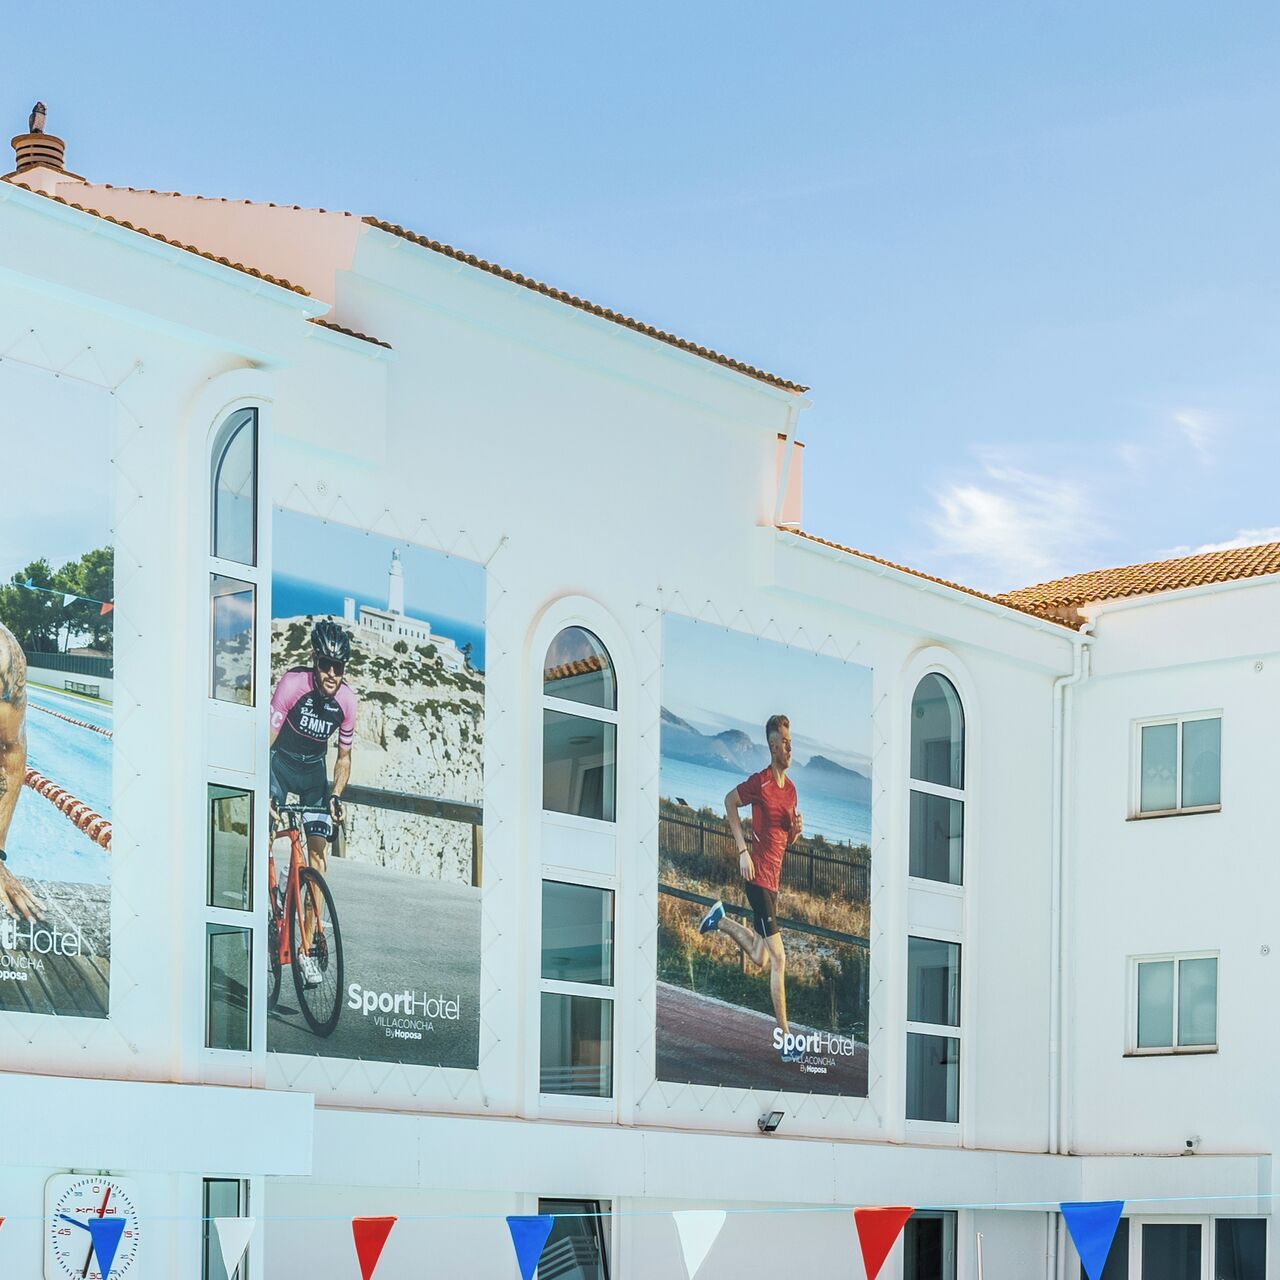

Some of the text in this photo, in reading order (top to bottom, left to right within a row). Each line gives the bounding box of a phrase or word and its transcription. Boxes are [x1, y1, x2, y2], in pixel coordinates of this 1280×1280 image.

[300, 716, 333, 734] BMNT
[347, 983, 460, 1020] SportHotel
[373, 1016, 434, 1031] VILLACONCHA
[773, 1027, 855, 1056] SportHotel
[57, 1228, 71, 1236] 45
[123, 1230, 133, 1238] 15
[89, 1272, 102, 1280] 30
